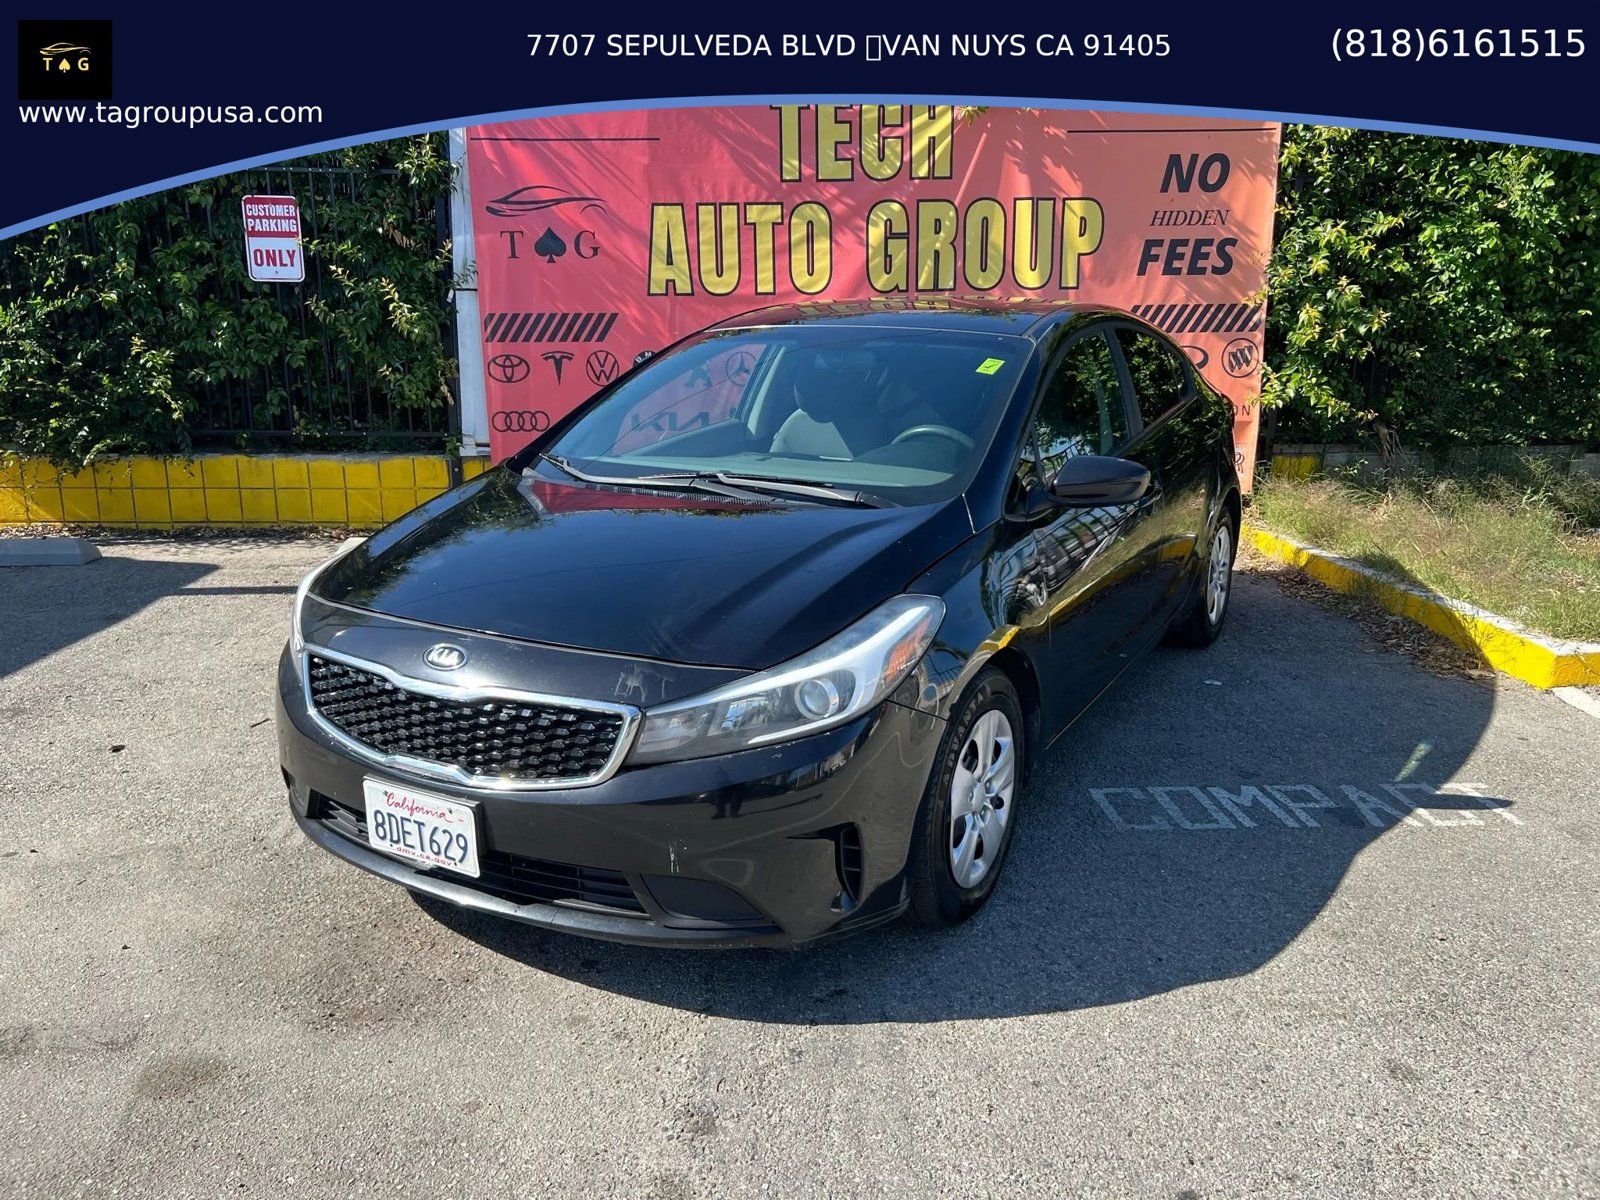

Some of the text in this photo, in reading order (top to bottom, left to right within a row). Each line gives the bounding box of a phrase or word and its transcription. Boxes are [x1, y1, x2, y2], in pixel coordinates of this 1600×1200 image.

[770, 104, 954, 182] TECH
[1160, 152, 1231, 193] NO
[245, 203, 296, 217] CUSTOMER
[247, 218, 298, 232] PARKING
[1150, 209, 1231, 227] HIDDEN
[253, 248, 296, 267] ONLY
[648, 197, 1104, 297] AUTO GROUP
[1136, 237, 1238, 277] FEES
[386, 792, 454, 824] California
[1088, 782, 1525, 830] COMPACT
[373, 809, 468, 864] 8DET629
[396, 846, 452, 866] dmv.ca.gov
